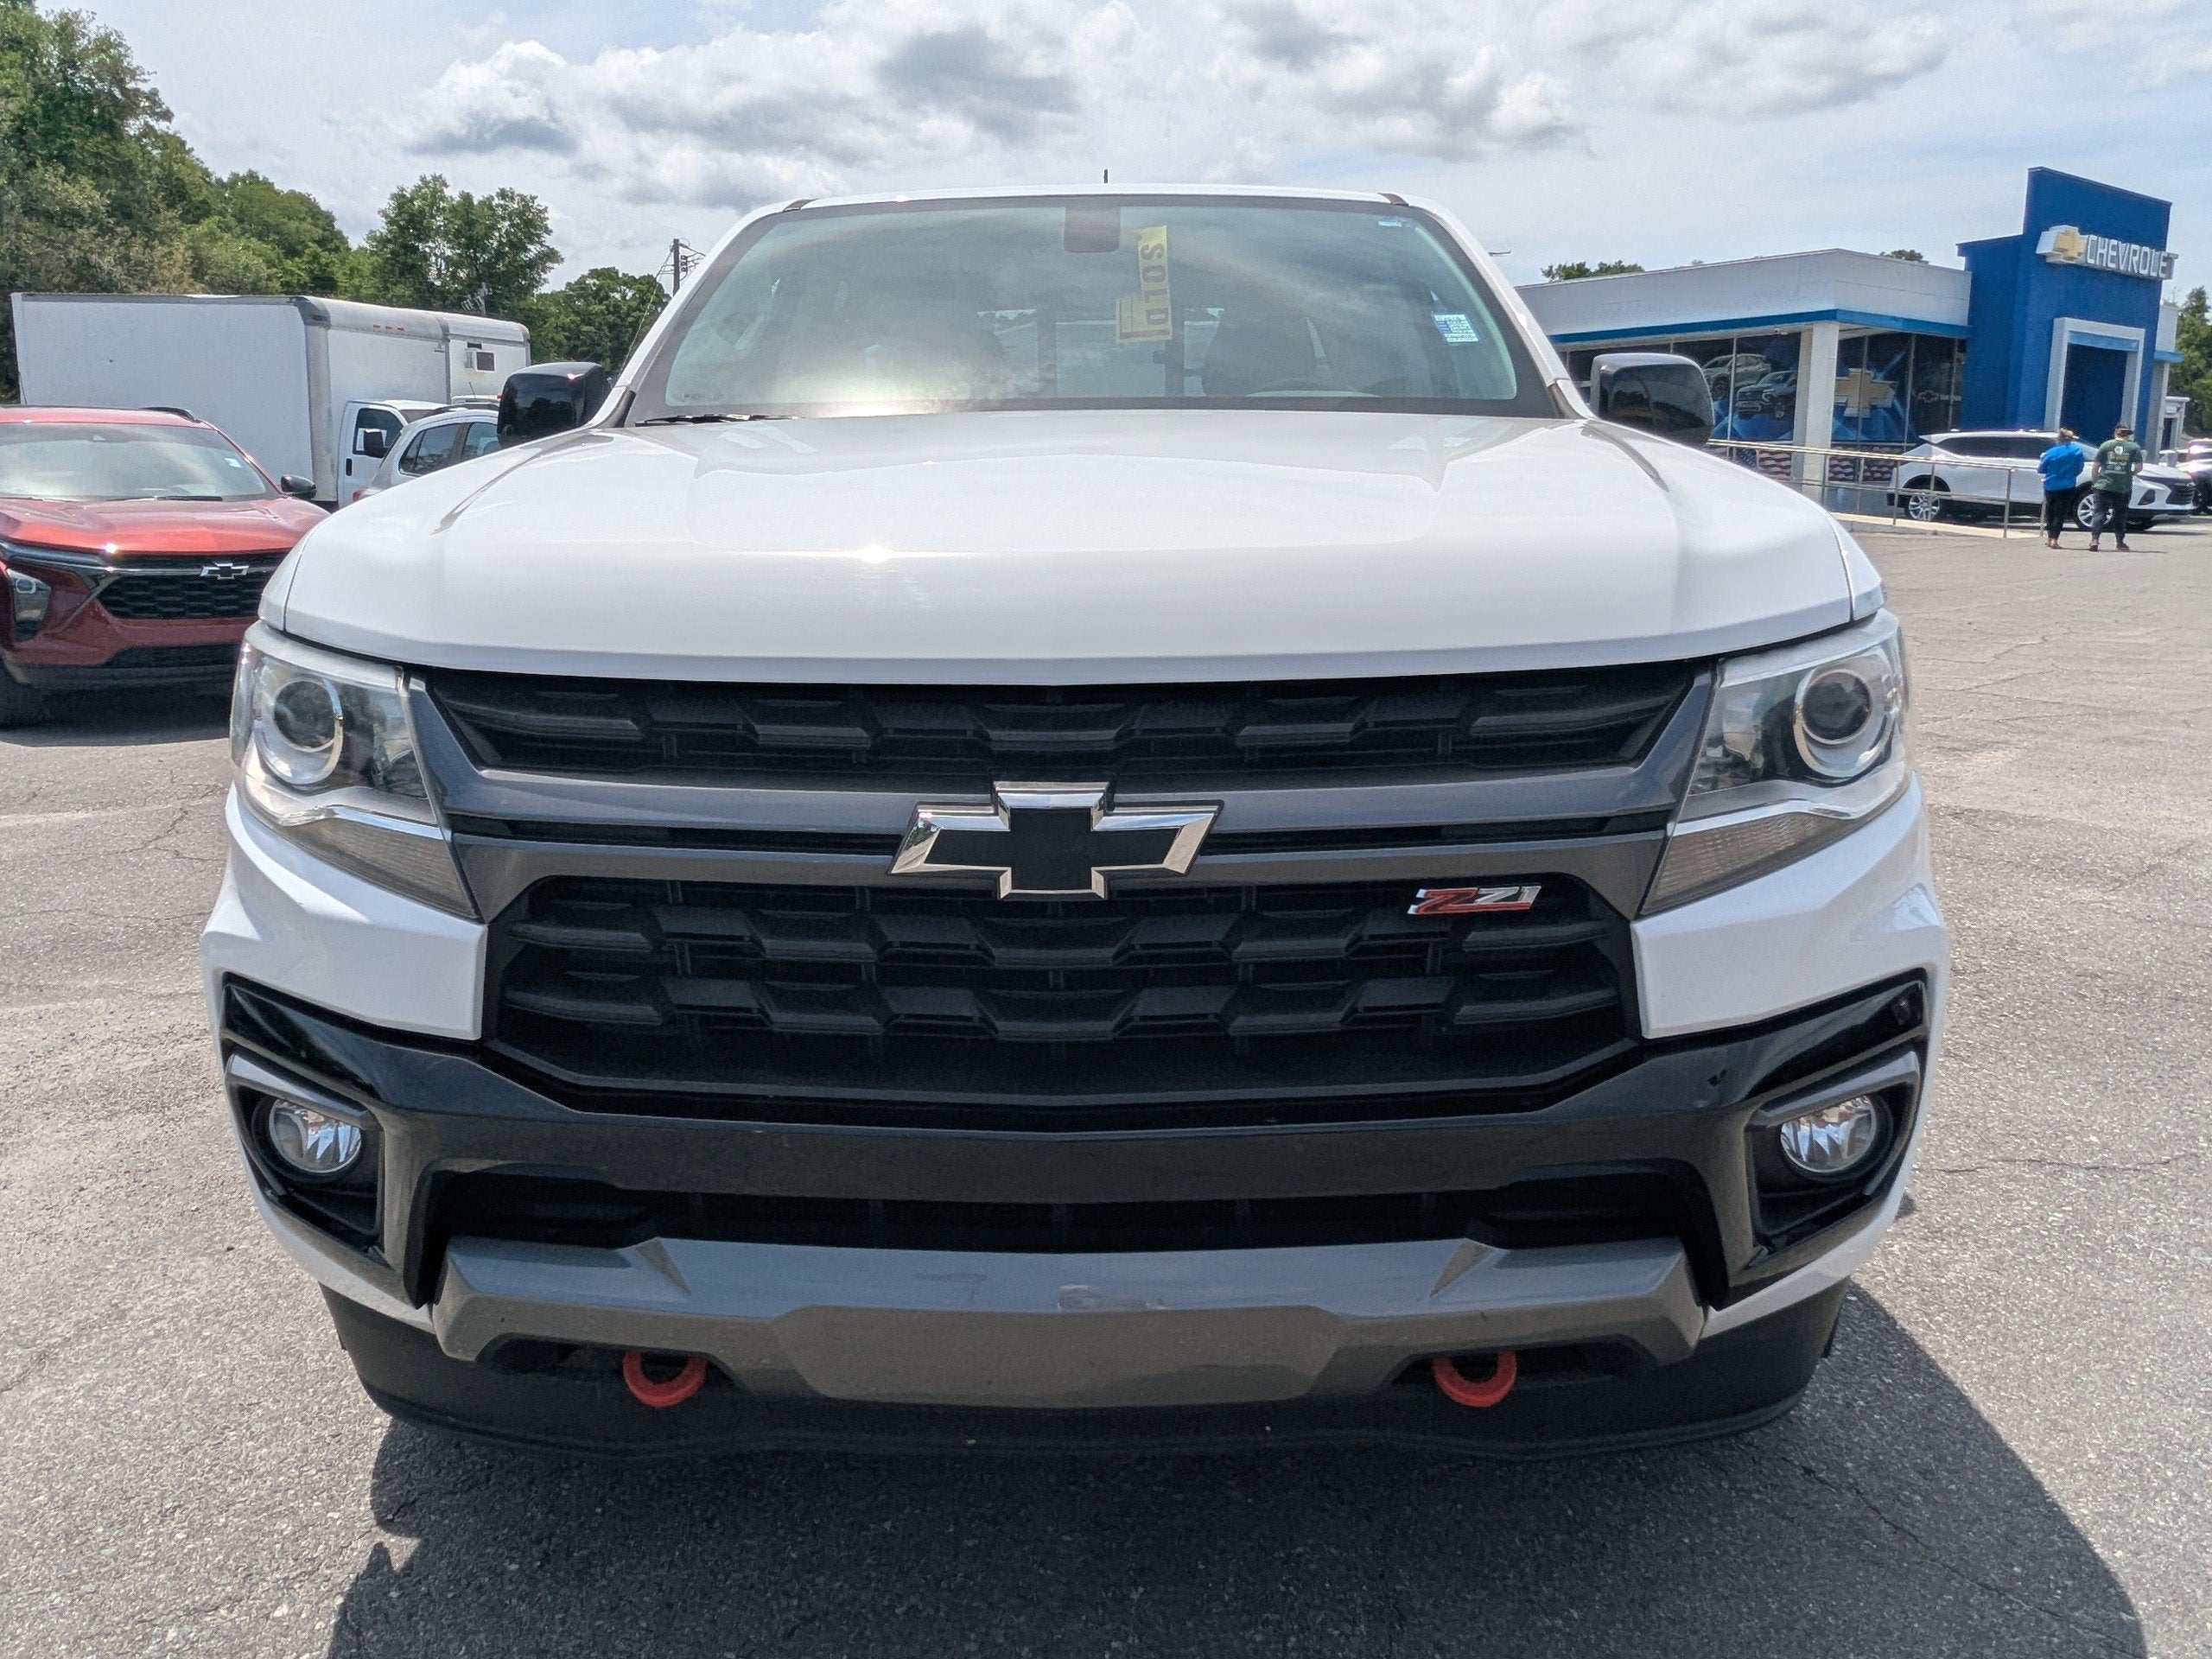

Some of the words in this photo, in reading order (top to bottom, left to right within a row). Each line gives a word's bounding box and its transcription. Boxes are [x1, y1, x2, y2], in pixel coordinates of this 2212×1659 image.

[2086, 234, 2179, 279] CHEVROLET
[1141, 243, 1169, 325] SOLD
[1407, 886, 1542, 915] Z71
